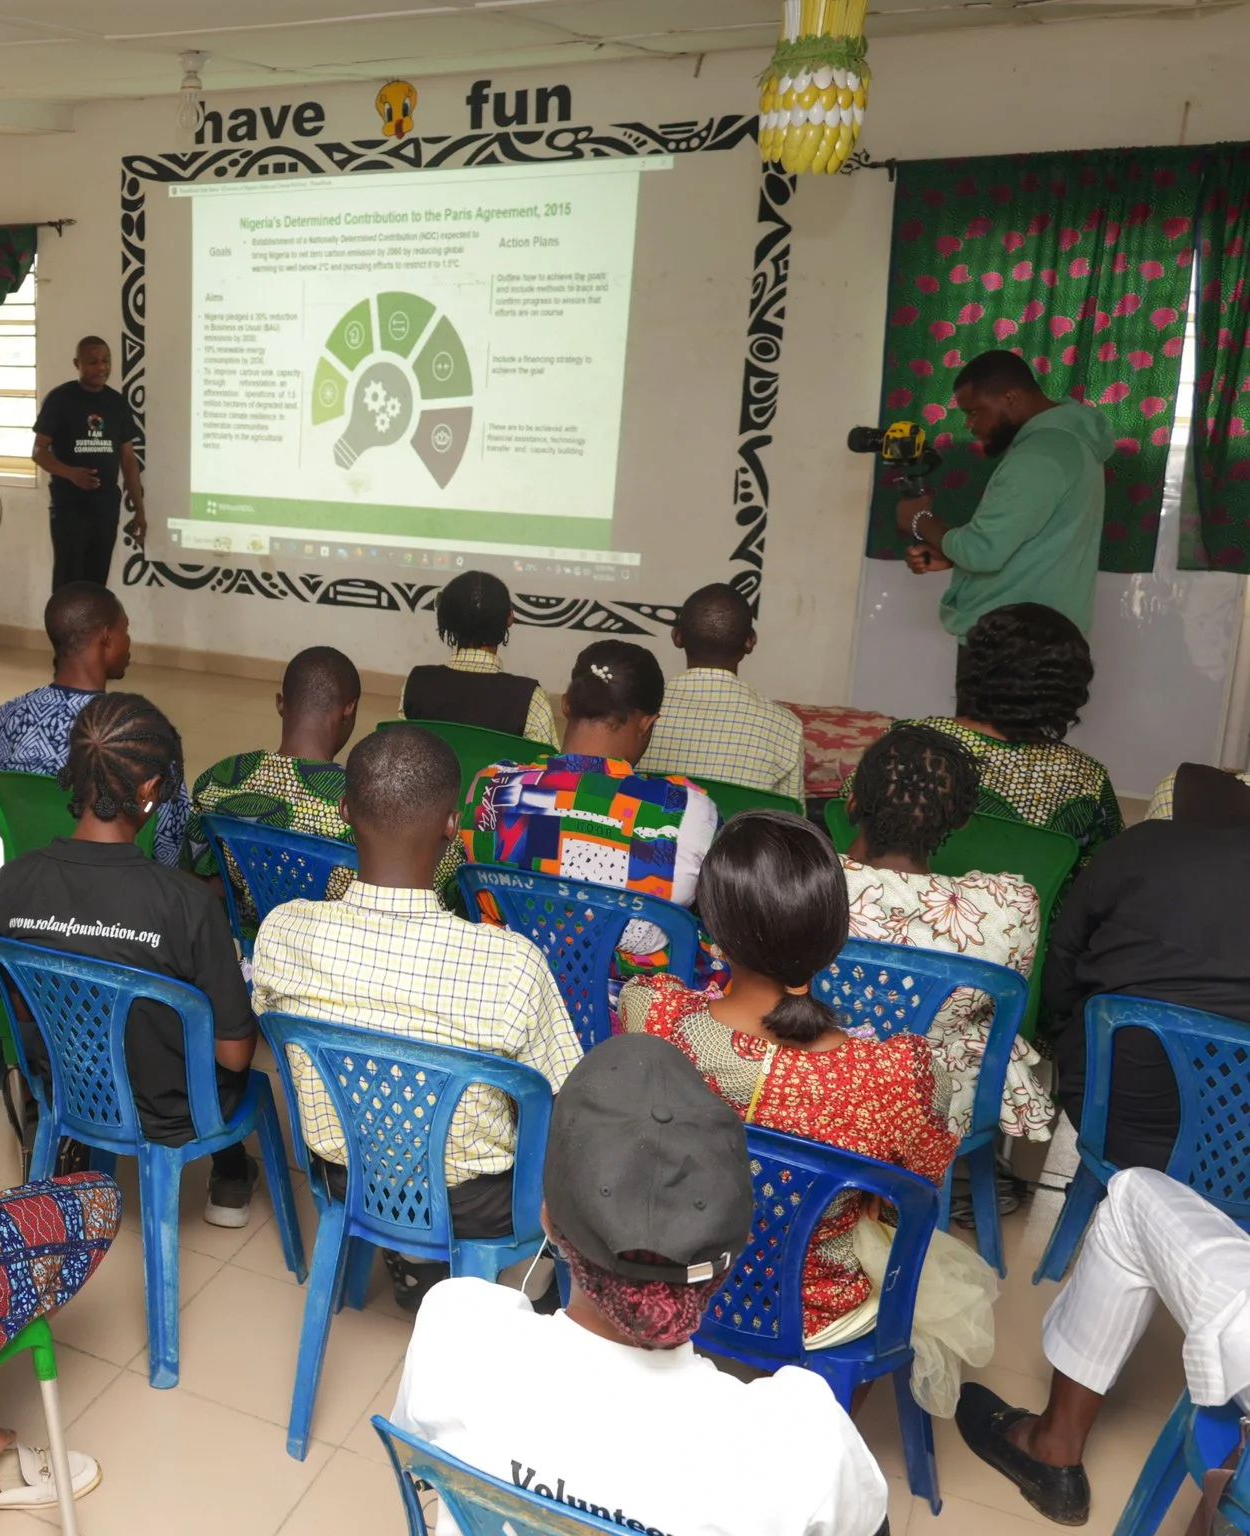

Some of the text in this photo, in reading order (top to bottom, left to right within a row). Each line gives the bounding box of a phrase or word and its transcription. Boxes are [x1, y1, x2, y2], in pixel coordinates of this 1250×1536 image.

[195, 79, 571, 145] have fun
[240, 216, 281, 232] Nigeria's
[284, 213, 341, 228] Determined
[344, 211, 408, 225] Contribution
[411, 210, 421, 222] to
[424, 209, 441, 222] the
[445, 208, 472, 221] Paris
[475, 205, 540, 222] Agreement,
[209, 246, 231, 257] Goals
[498, 235, 559, 248] Action Plans
[9, 915, 161, 948] www.rolanfoundation.org
